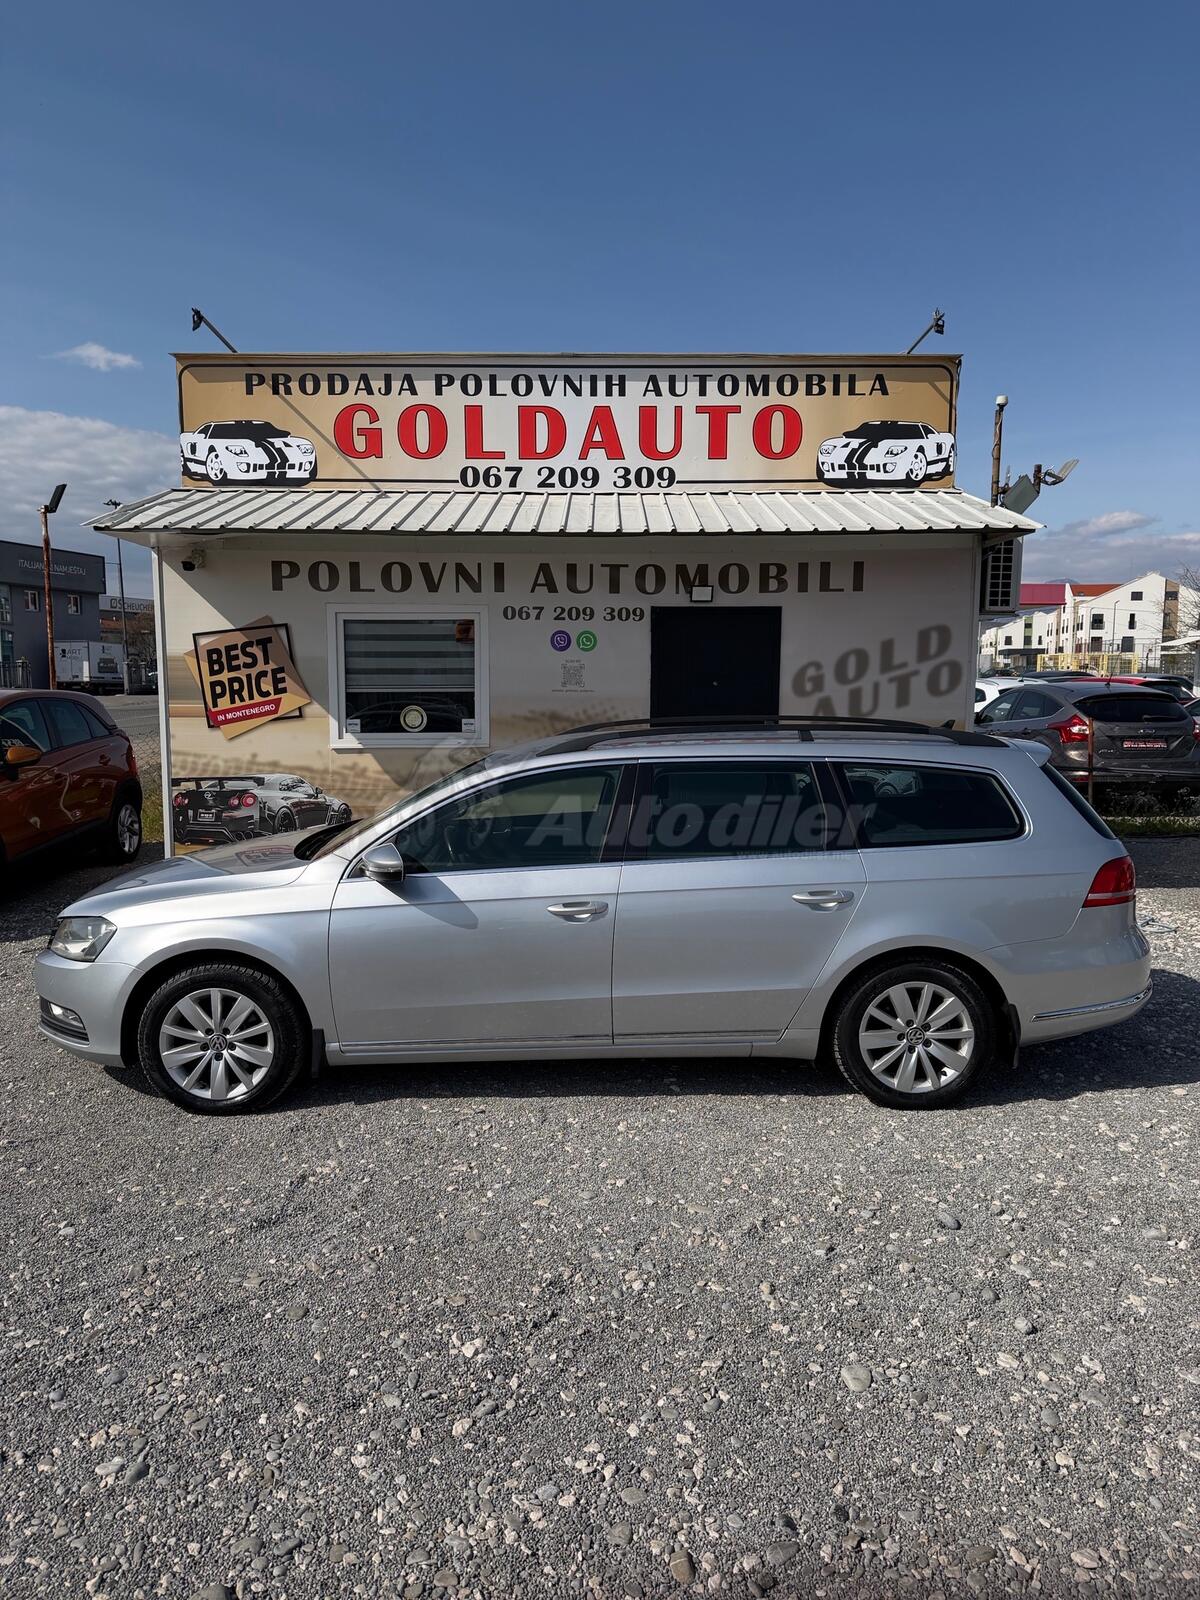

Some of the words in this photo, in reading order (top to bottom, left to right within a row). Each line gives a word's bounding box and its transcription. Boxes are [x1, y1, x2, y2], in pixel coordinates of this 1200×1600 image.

[245, 373, 419, 397] PRODAJA
[435, 373, 626, 397] POLOVNIH
[642, 373, 889, 396] AUTOMOBILA
[333, 403, 803, 461] GOLDAUTO
[460, 466, 525, 489] 067
[536, 466, 601, 490] 209
[612, 466, 677, 490] 309
[271, 560, 505, 593] POLOVNI
[530, 561, 865, 594] AUTOMOBILI
[502, 605, 544, 620] 067
[553, 606, 595, 621] 209
[603, 607, 645, 621] 309
[206, 638, 272, 676] BEST
[791, 624, 952, 698] GOLD
[209, 666, 287, 708] PRICE
[812, 659, 962, 724] AUTO
[217, 714, 226, 722] IN
[226, 704, 275, 720] MONTENEGRO
